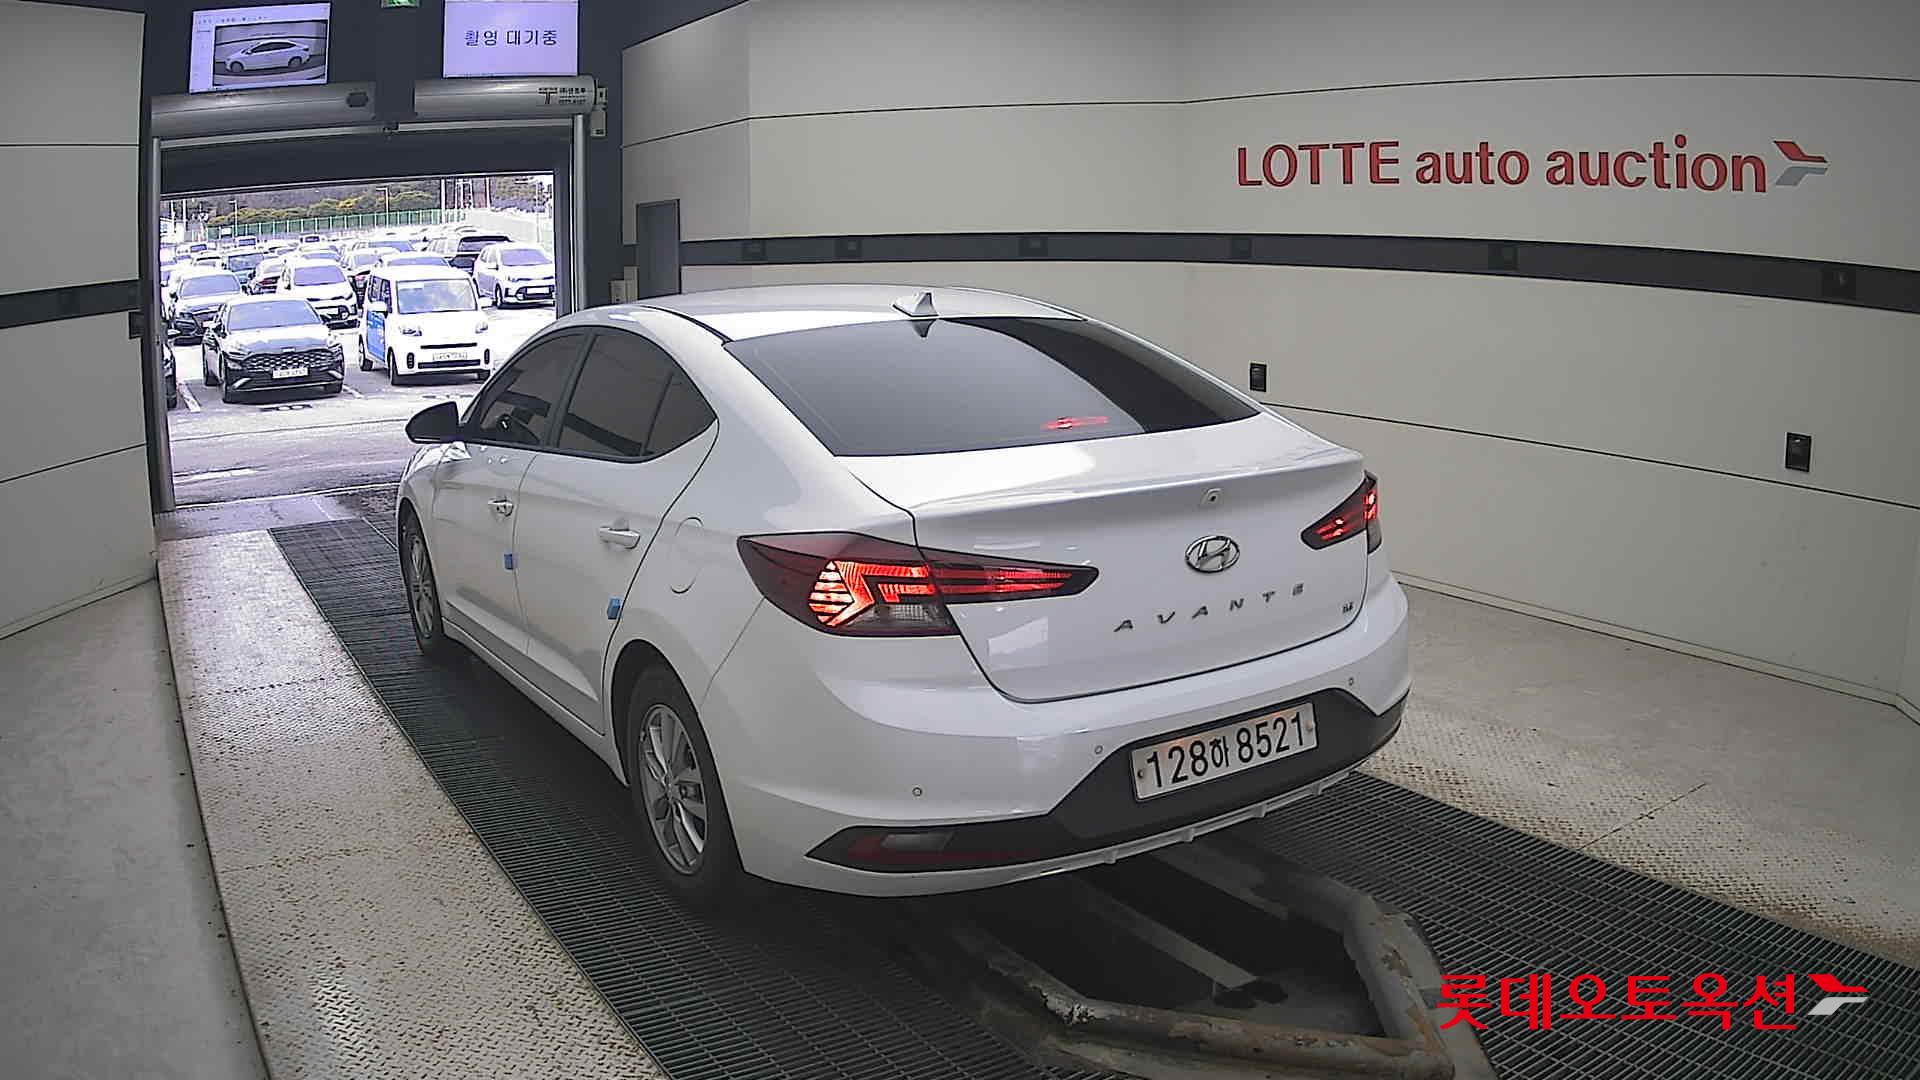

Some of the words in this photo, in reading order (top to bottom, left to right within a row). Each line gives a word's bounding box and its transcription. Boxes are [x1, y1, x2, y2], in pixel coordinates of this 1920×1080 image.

[506, 29, 557, 46] 대기중
[1238, 140, 1400, 187] LOTTE
[1415, 141, 1531, 186] auto
[1545, 134, 1767, 193] auction
[1113, 583, 1306, 633] AVANTE
[1146, 735, 1230, 788] 128하
[1236, 711, 1305, 764] 8521
